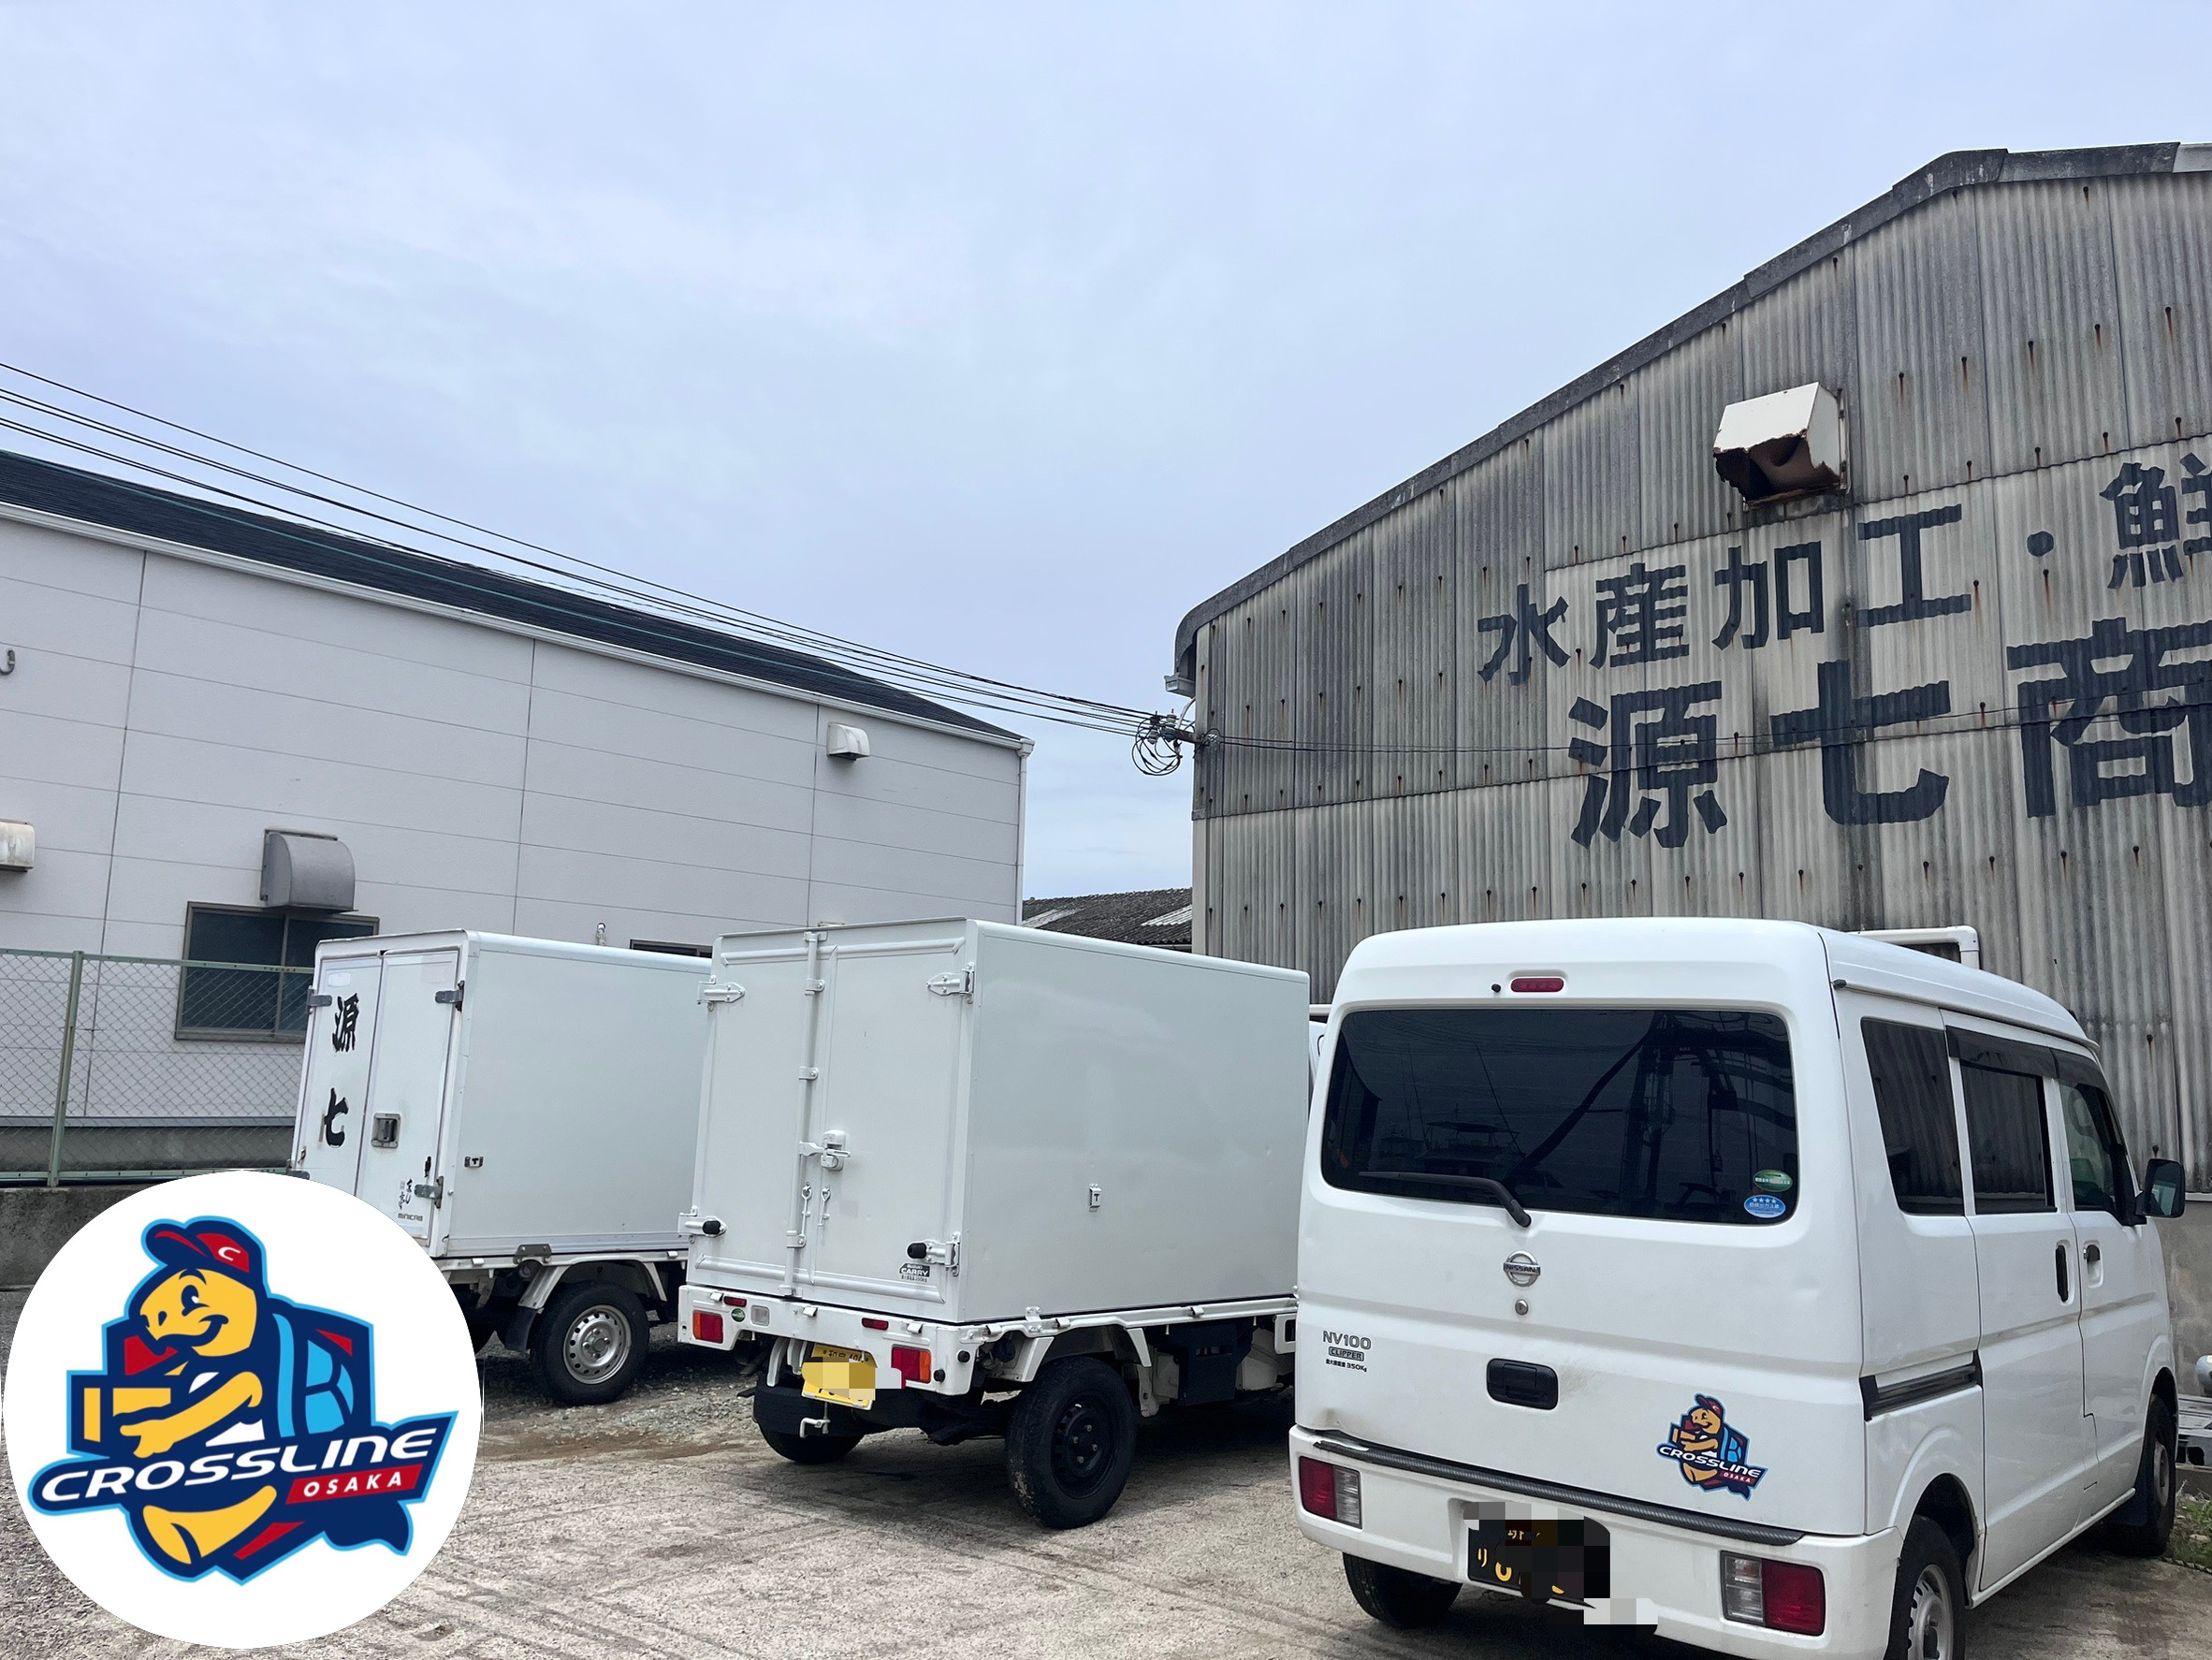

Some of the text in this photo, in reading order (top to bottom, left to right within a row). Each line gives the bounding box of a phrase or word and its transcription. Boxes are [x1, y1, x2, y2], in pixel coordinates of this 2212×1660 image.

[324, 993, 359, 1147] 源七
[901, 1267, 928, 1276] CARRY
[1506, 1264, 1535, 1273] NISSAN
[1323, 1331, 1372, 1350] NV100
[1331, 1348, 1362, 1360] CLIPPER
[1659, 1447, 1762, 1478] CROSSLINE
[1724, 1473, 1752, 1483] OSAKA
